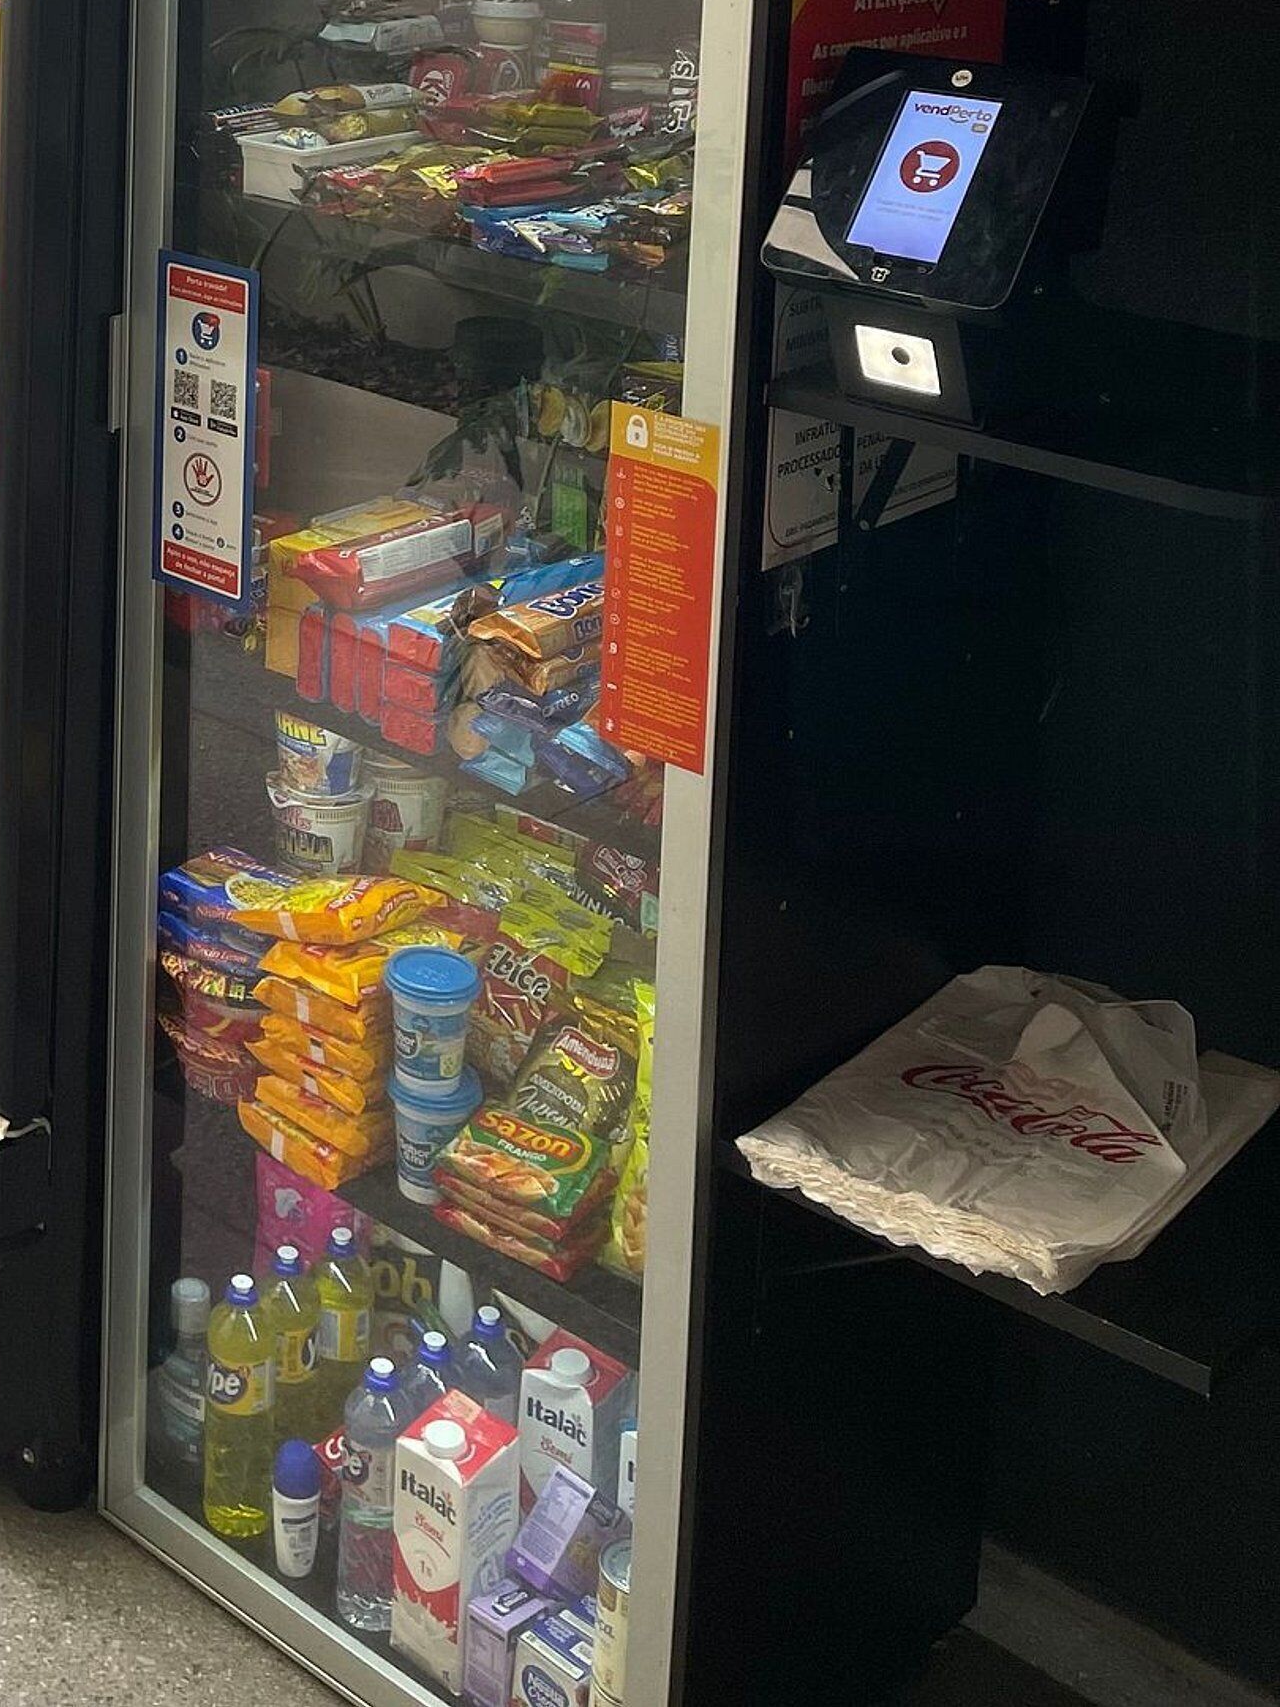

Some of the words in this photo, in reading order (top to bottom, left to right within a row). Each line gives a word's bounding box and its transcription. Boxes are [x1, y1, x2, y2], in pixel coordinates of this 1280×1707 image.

[900, 1063, 1163, 1164] Coca-Cola
[498, 1139, 547, 1162] FRANGO
[526, 1396, 588, 1448] Italac
[400, 1468, 457, 1527] Italac
